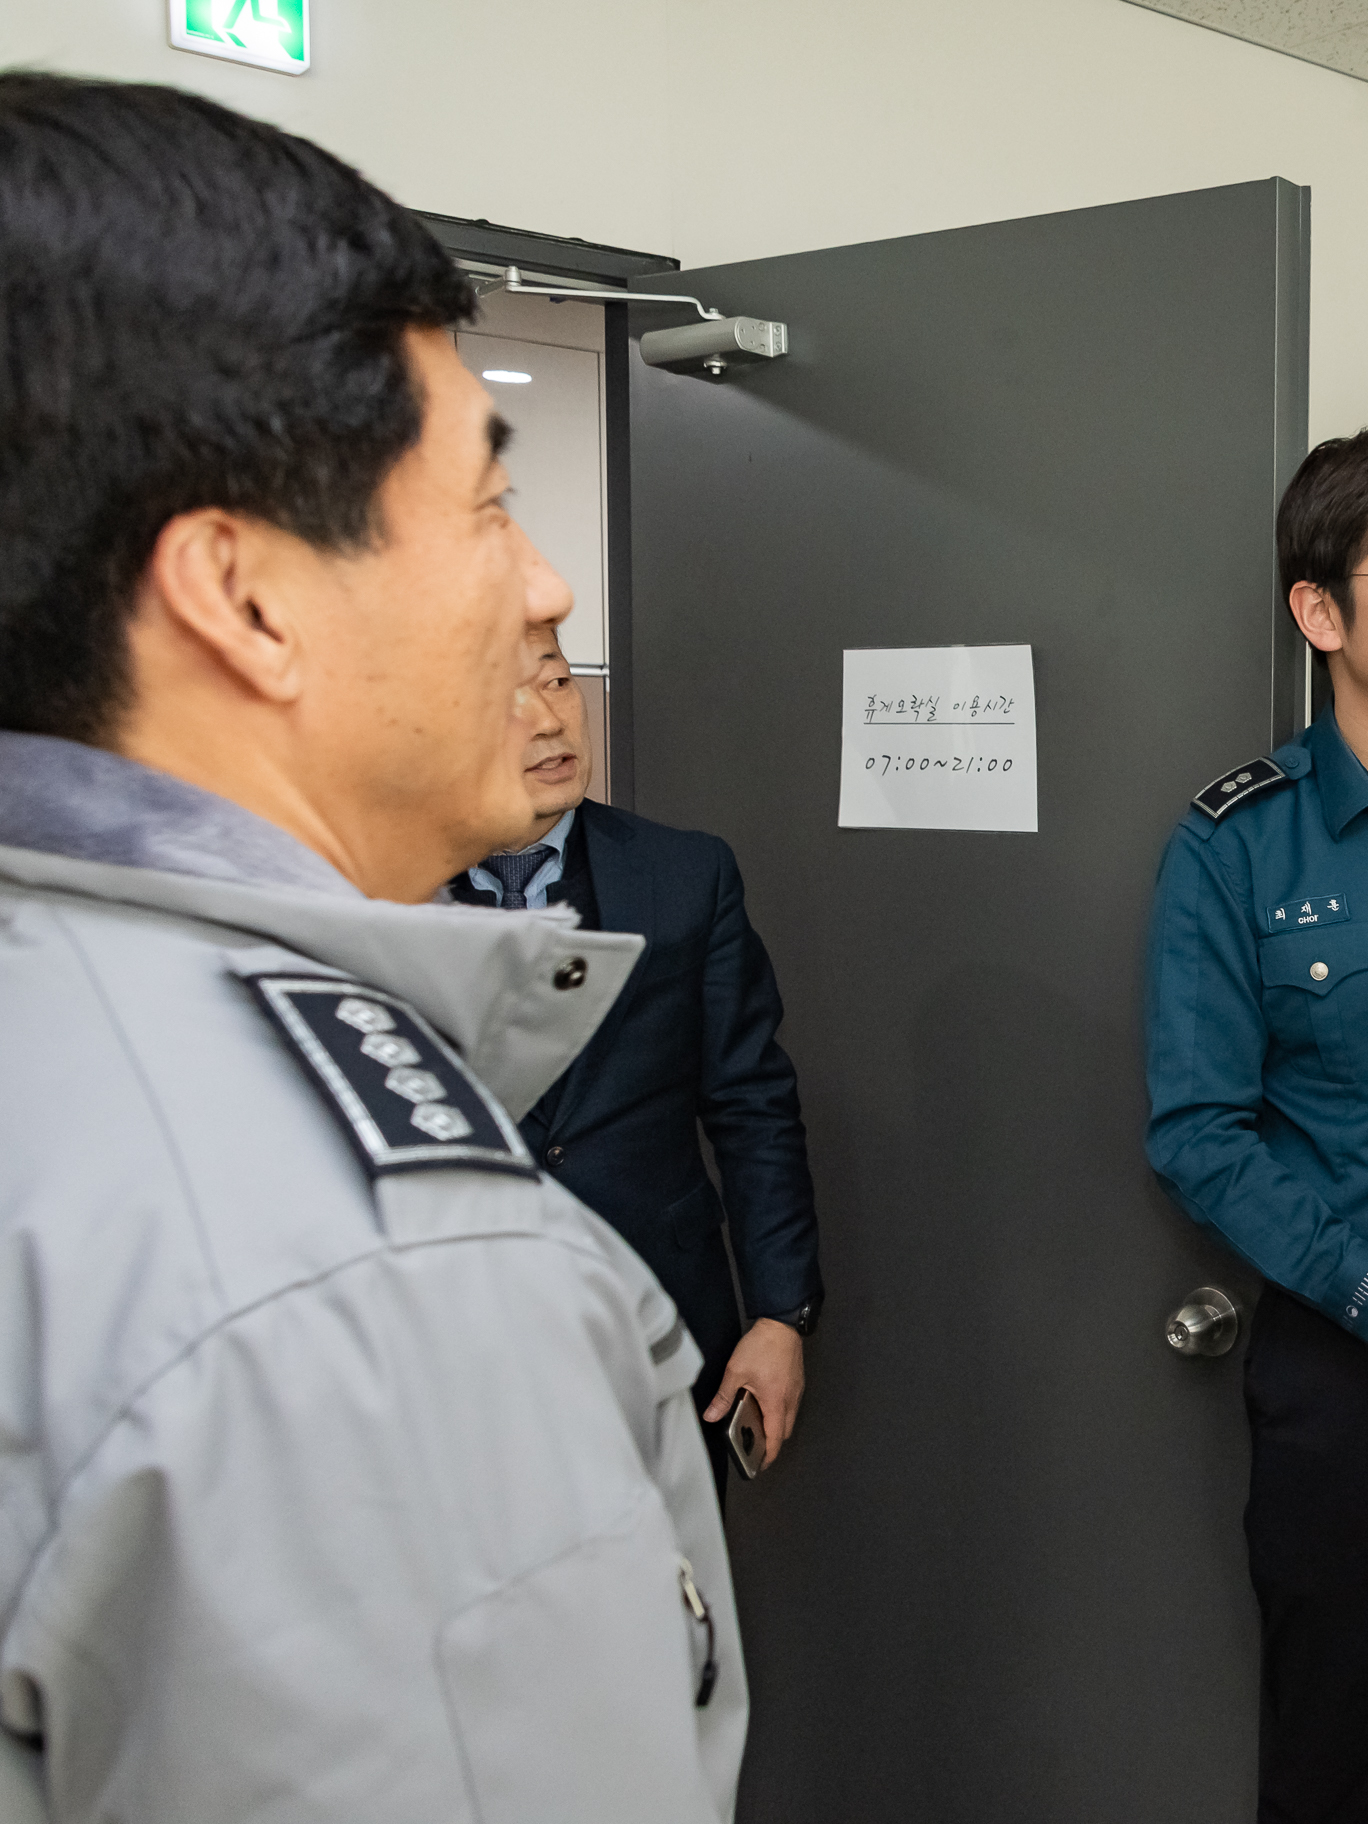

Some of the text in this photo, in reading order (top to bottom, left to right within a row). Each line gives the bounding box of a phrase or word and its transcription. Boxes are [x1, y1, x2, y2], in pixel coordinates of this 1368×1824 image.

[865, 694, 1015, 723] 휴게오락실 이용시간
[865, 754, 1013, 776] 07:00~21:00
